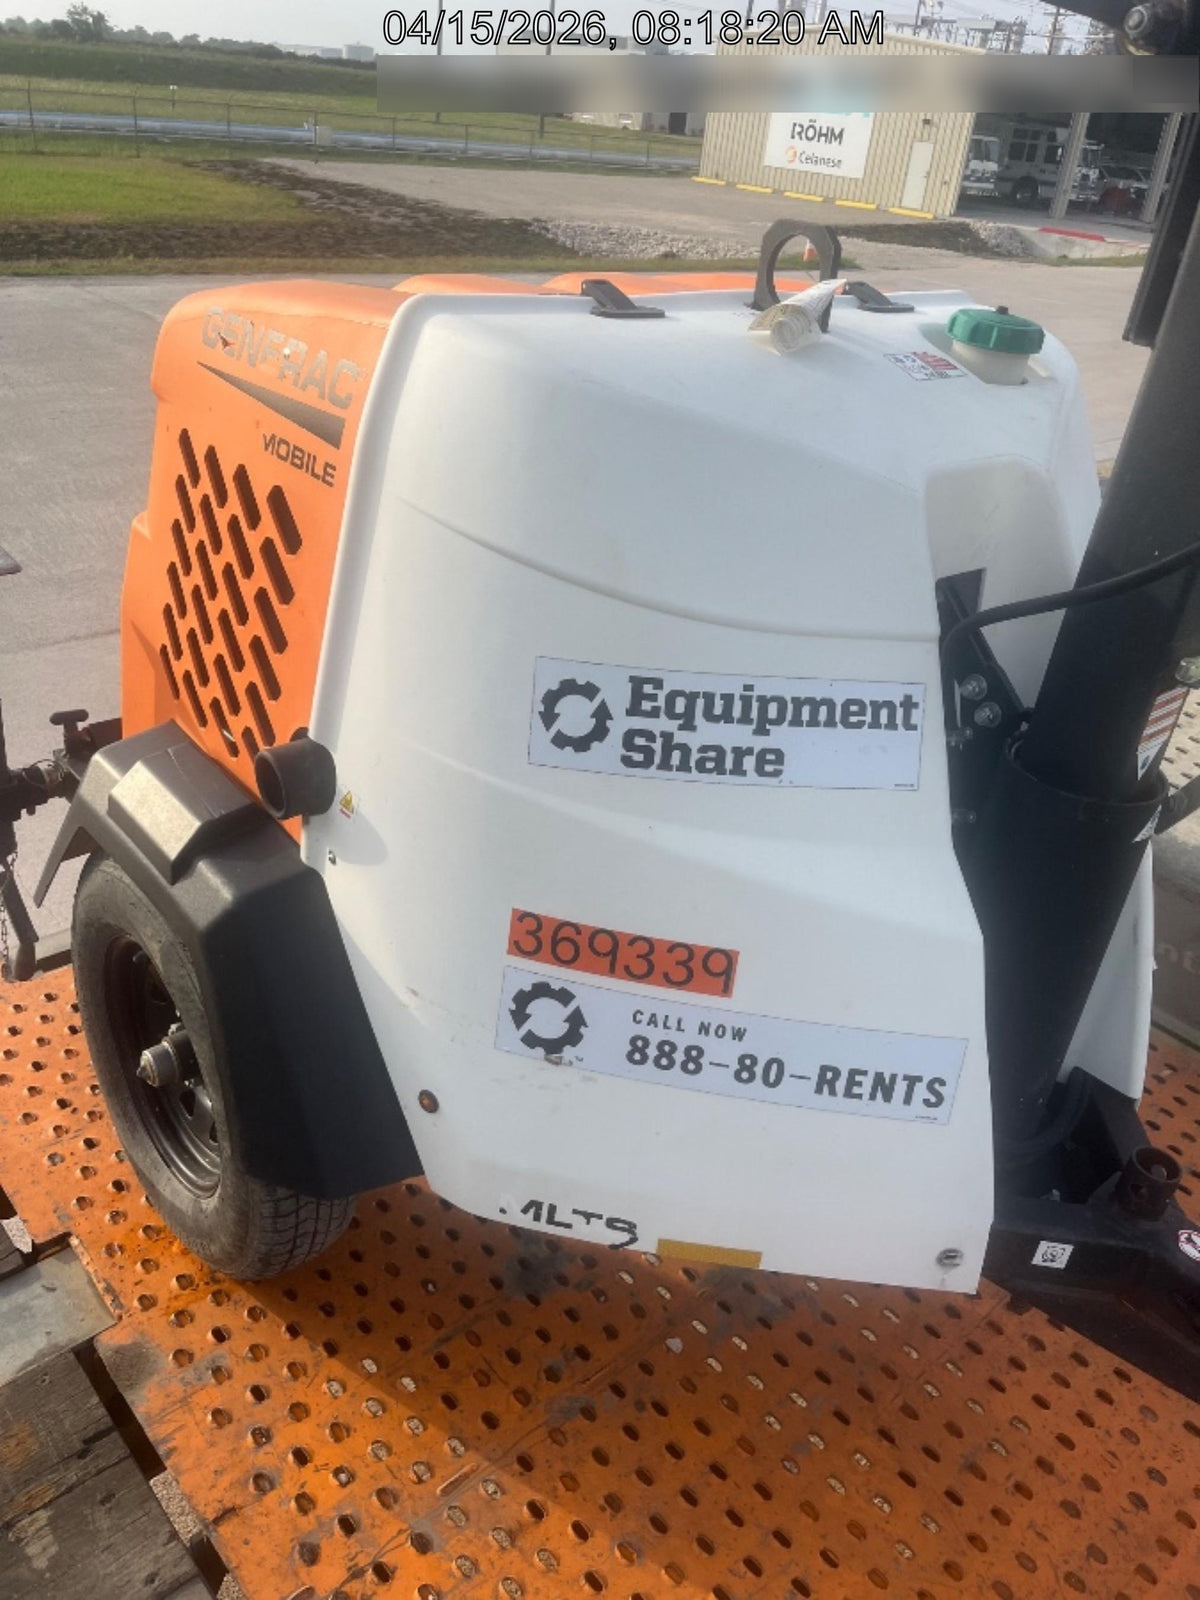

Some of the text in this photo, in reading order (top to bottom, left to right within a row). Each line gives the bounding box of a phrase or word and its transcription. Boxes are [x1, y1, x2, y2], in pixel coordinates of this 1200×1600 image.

[790, 119, 845, 145] RÖHM
[626, 675, 919, 736] Equipment
[620, 728, 785, 778] Share
[512, 912, 734, 994] 369339
[632, 1010, 748, 1043] CALL NOW
[625, 1034, 948, 1109] 888-80-RENTS
